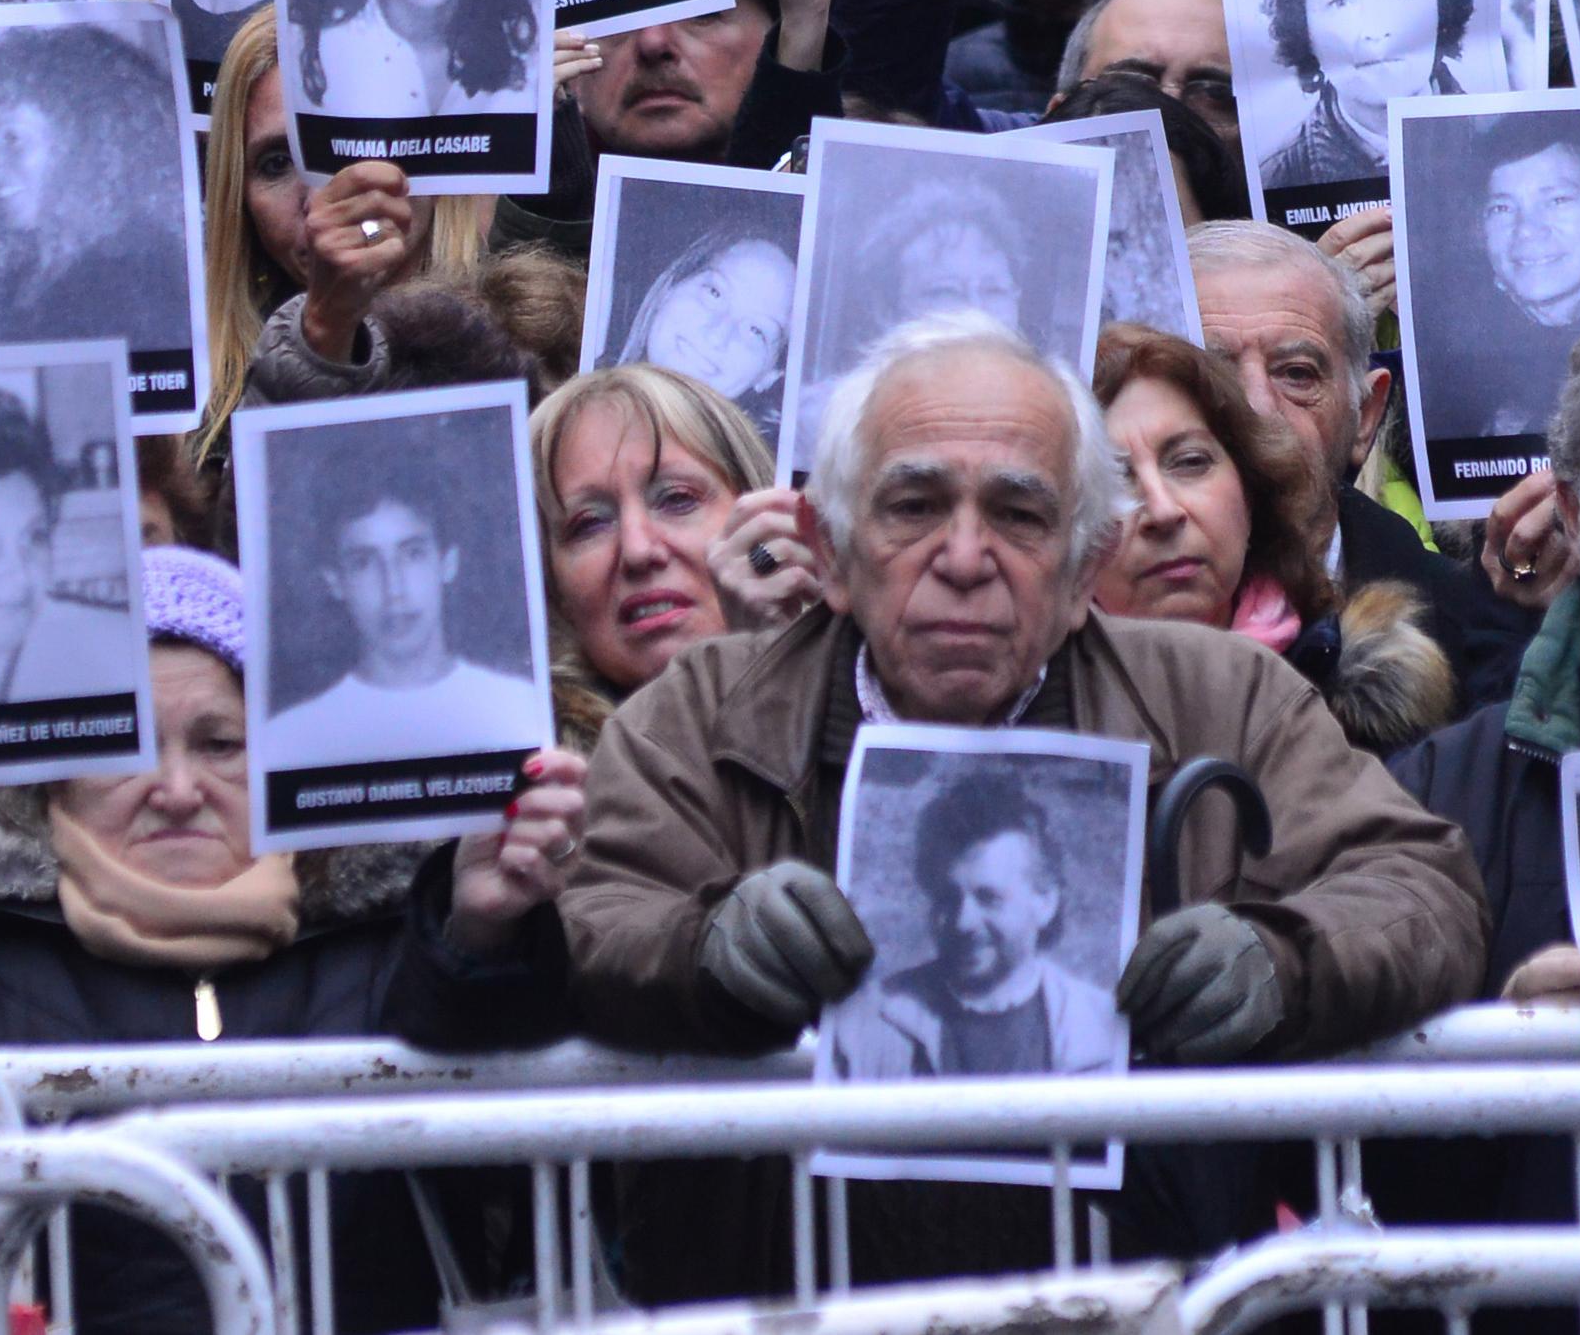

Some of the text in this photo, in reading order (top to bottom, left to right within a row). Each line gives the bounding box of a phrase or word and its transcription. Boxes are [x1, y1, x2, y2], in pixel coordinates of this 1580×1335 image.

[331, 134, 491, 158] VIVIANA ADELA CASABE
[1285, 203, 1331, 225] EMILIA
[149, 372, 188, 391] TOER
[1454, 458, 1527, 479] FERNANDO
[30, 723, 50, 743] DE
[52, 716, 133, 740] VELAZQUEZ
[296, 773, 515, 810] GUSTAVO DANIEL VELAZQUEZ
